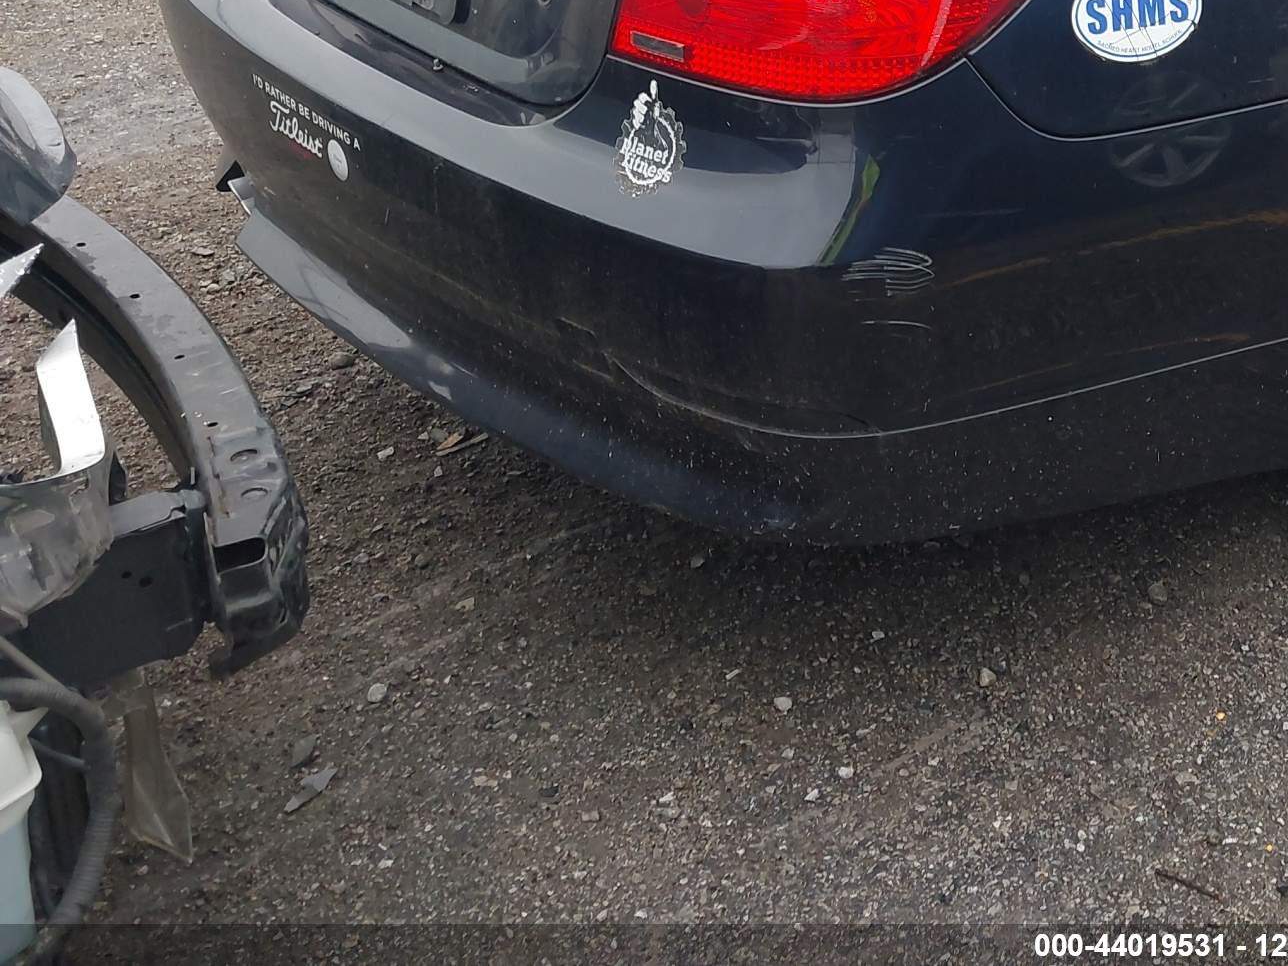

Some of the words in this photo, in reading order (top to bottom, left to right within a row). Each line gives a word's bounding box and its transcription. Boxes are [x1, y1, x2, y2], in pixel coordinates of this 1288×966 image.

[1121, 46, 1140, 54] HEART
[252, 74, 263, 89] I'D
[264, 81, 297, 112] RATHER
[298, 103, 311, 121] BE
[311, 111, 351, 145] DRIVING
[353, 138, 360, 151] A
[269, 100, 323, 159] Titleist
